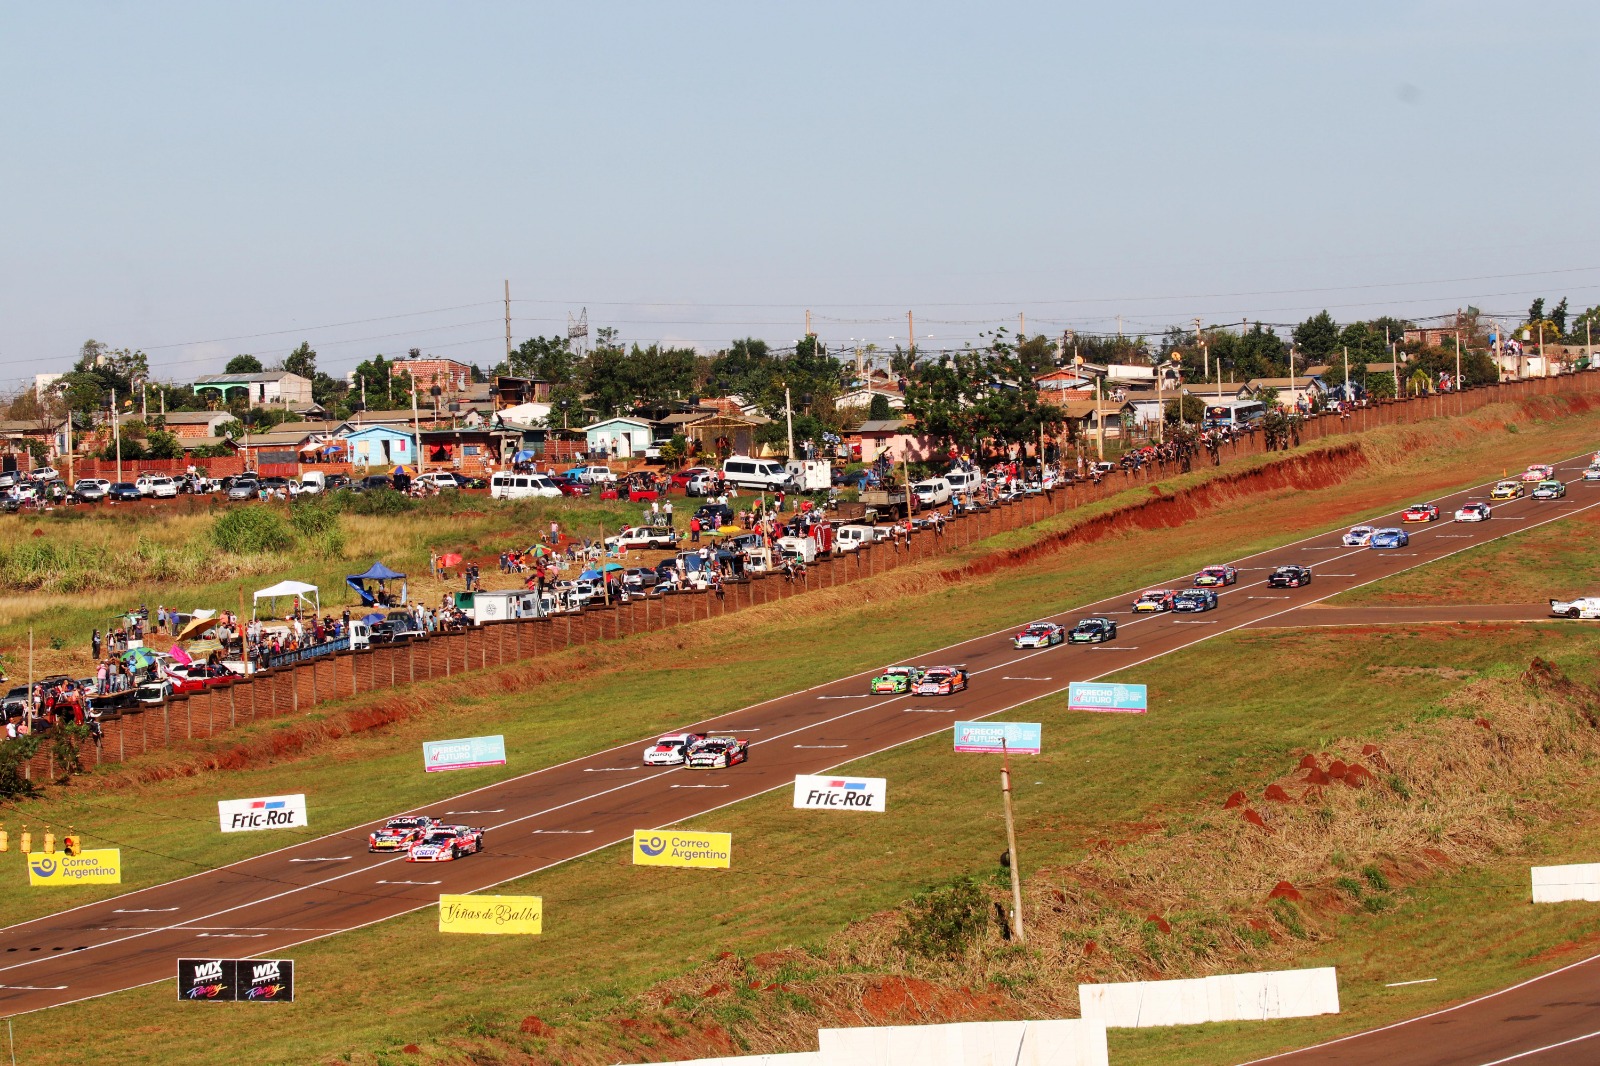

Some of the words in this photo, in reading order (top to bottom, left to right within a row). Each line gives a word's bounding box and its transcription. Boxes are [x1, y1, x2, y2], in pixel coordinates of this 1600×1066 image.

[1076, 688, 1112, 697] DERECHO
[1081, 696, 1112, 704] FUTURO
[963, 727, 1004, 735] DERECHO
[432, 744, 470, 754] DERECHO
[438, 752, 471, 761] FUTURO
[806, 789, 874, 807] Fric-Rot
[231, 809, 295, 829] Fric-Rot
[671, 837, 710, 848] Correo
[671, 848, 727, 861] Argentino
[61, 857, 98, 867] Correo
[62, 866, 116, 879] Argentino
[440, 903, 482, 924] Viñas
[482, 908, 494, 920] de
[494, 904, 540, 925] Balbo
[194, 960, 222, 978] WIX
[252, 960, 280, 978] WIX
[186, 983, 228, 999] Racing
[245, 983, 286, 1000] Racing
